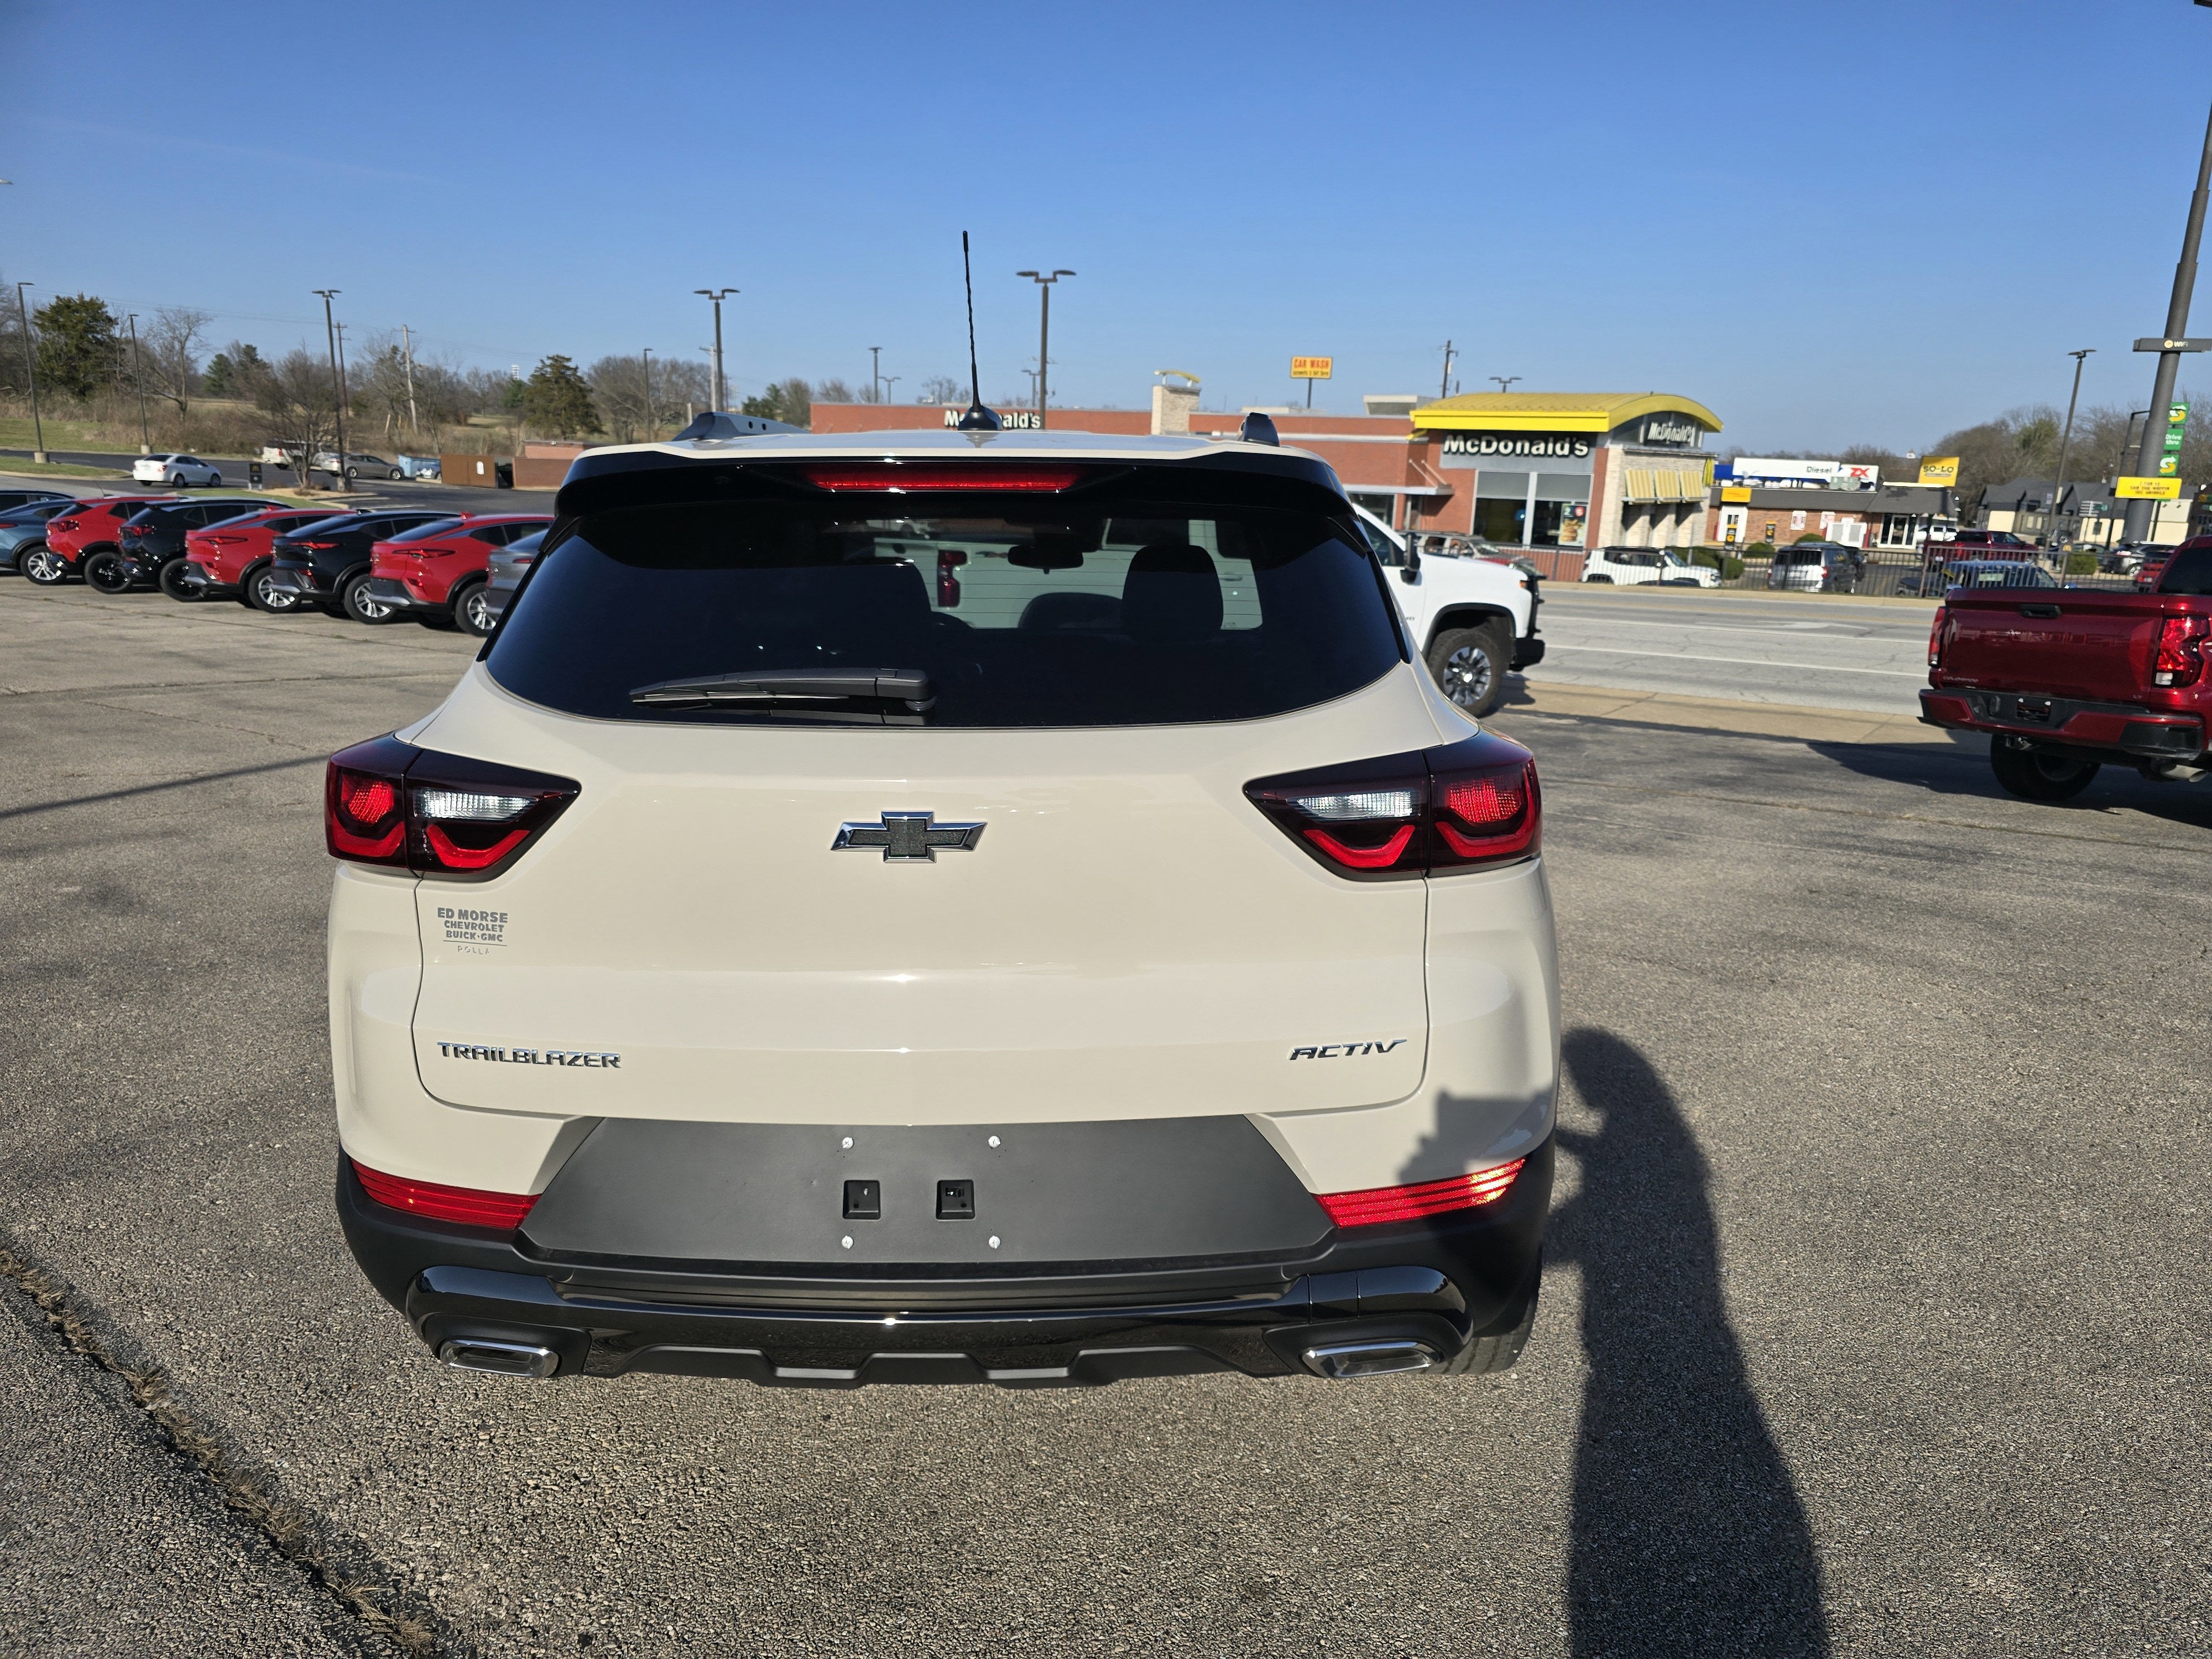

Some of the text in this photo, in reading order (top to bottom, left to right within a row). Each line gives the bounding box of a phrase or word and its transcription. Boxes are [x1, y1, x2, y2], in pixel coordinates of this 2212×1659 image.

[1294, 359, 1329, 369] CAR WASH
[1443, 435, 1589, 456] McDonald's
[437, 907, 508, 923] ED MORSE
[444, 920, 504, 932] CHEVROLET
[437, 1042, 622, 1068] TRAILBLAZER
[1289, 1039, 1407, 1061] ACTIV
